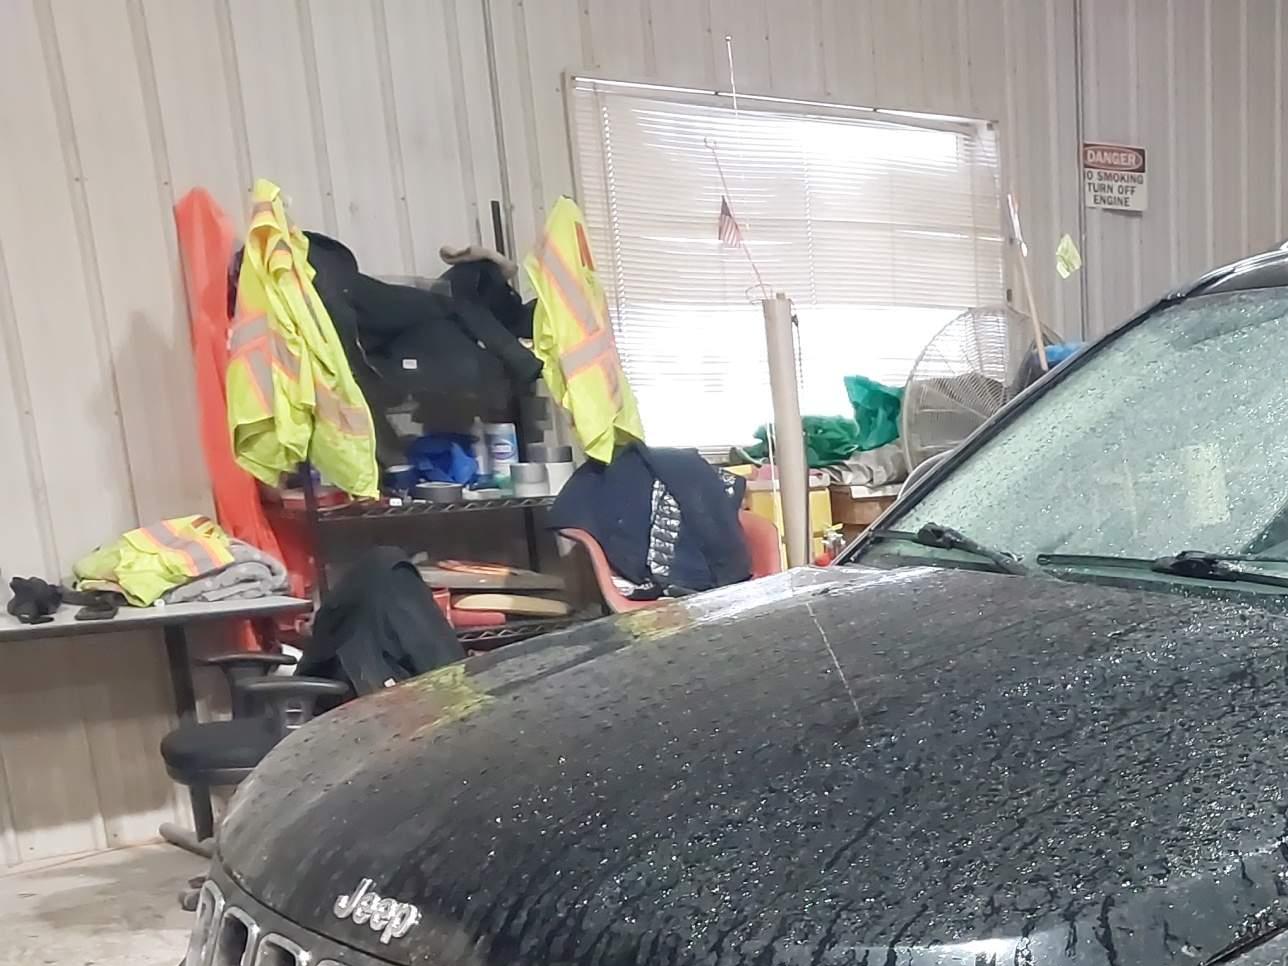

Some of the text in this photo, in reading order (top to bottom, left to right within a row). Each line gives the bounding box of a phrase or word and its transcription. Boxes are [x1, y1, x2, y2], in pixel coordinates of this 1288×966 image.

[1087, 149, 1136, 166] DANGER
[1097, 171, 1144, 185] SMOKING
[1087, 182, 1136, 196] TURN OFF
[1093, 194, 1130, 207] ENGINE
[333, 878, 418, 944] Jeep
